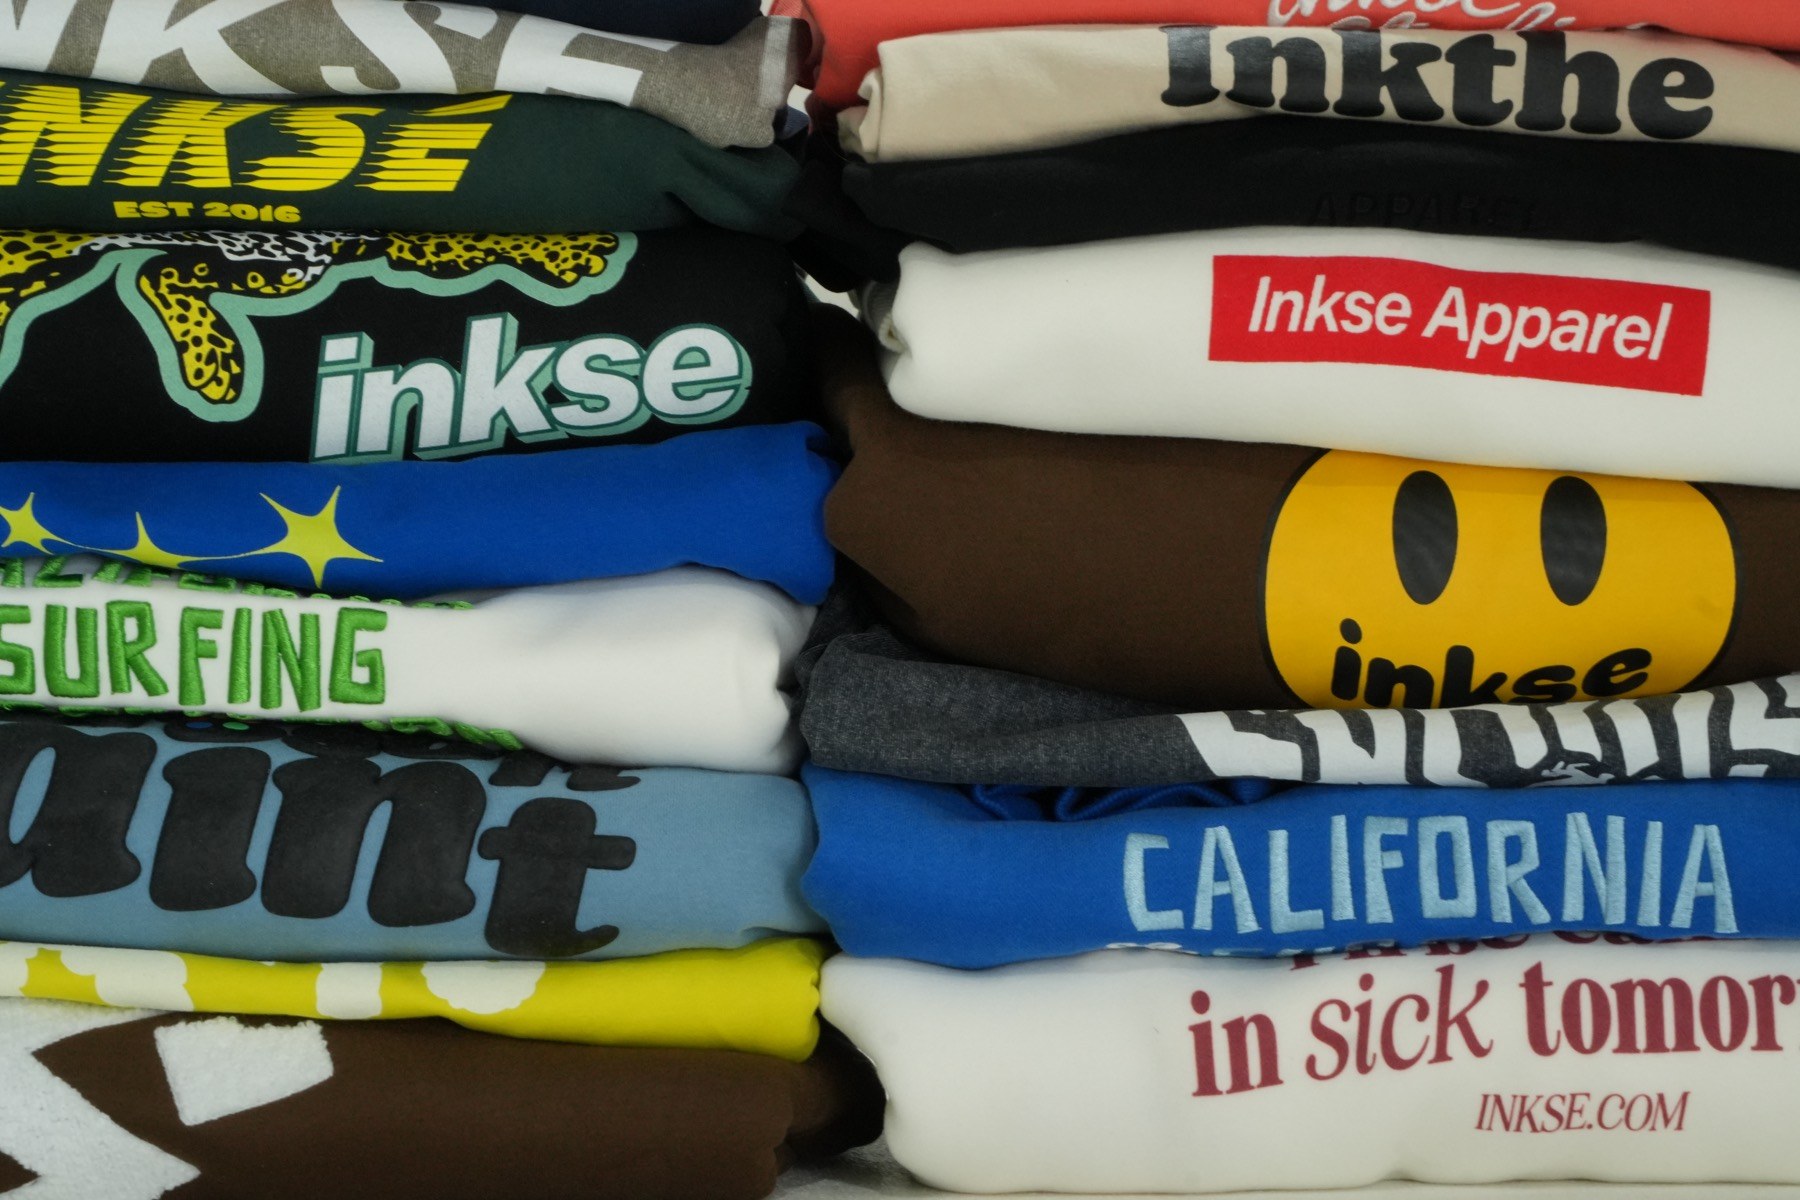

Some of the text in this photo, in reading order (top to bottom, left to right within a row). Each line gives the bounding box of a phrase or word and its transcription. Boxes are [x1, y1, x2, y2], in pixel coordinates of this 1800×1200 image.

[0, 82, 512, 192] NKSE
[1159, 24, 1714, 139] Inkthe
[113, 201, 302, 223] EST 2016
[1248, 275, 1673, 363] Inkse Apparel
[309, 312, 753, 464] inkse
[0, 600, 388, 712] SURFING
[1331, 618, 1653, 709] inkse
[1123, 812, 1739, 934] CALIFORNIA
[1188, 961, 1800, 1097] in sick tomor
[1474, 1091, 1691, 1133] INKSE.COM
